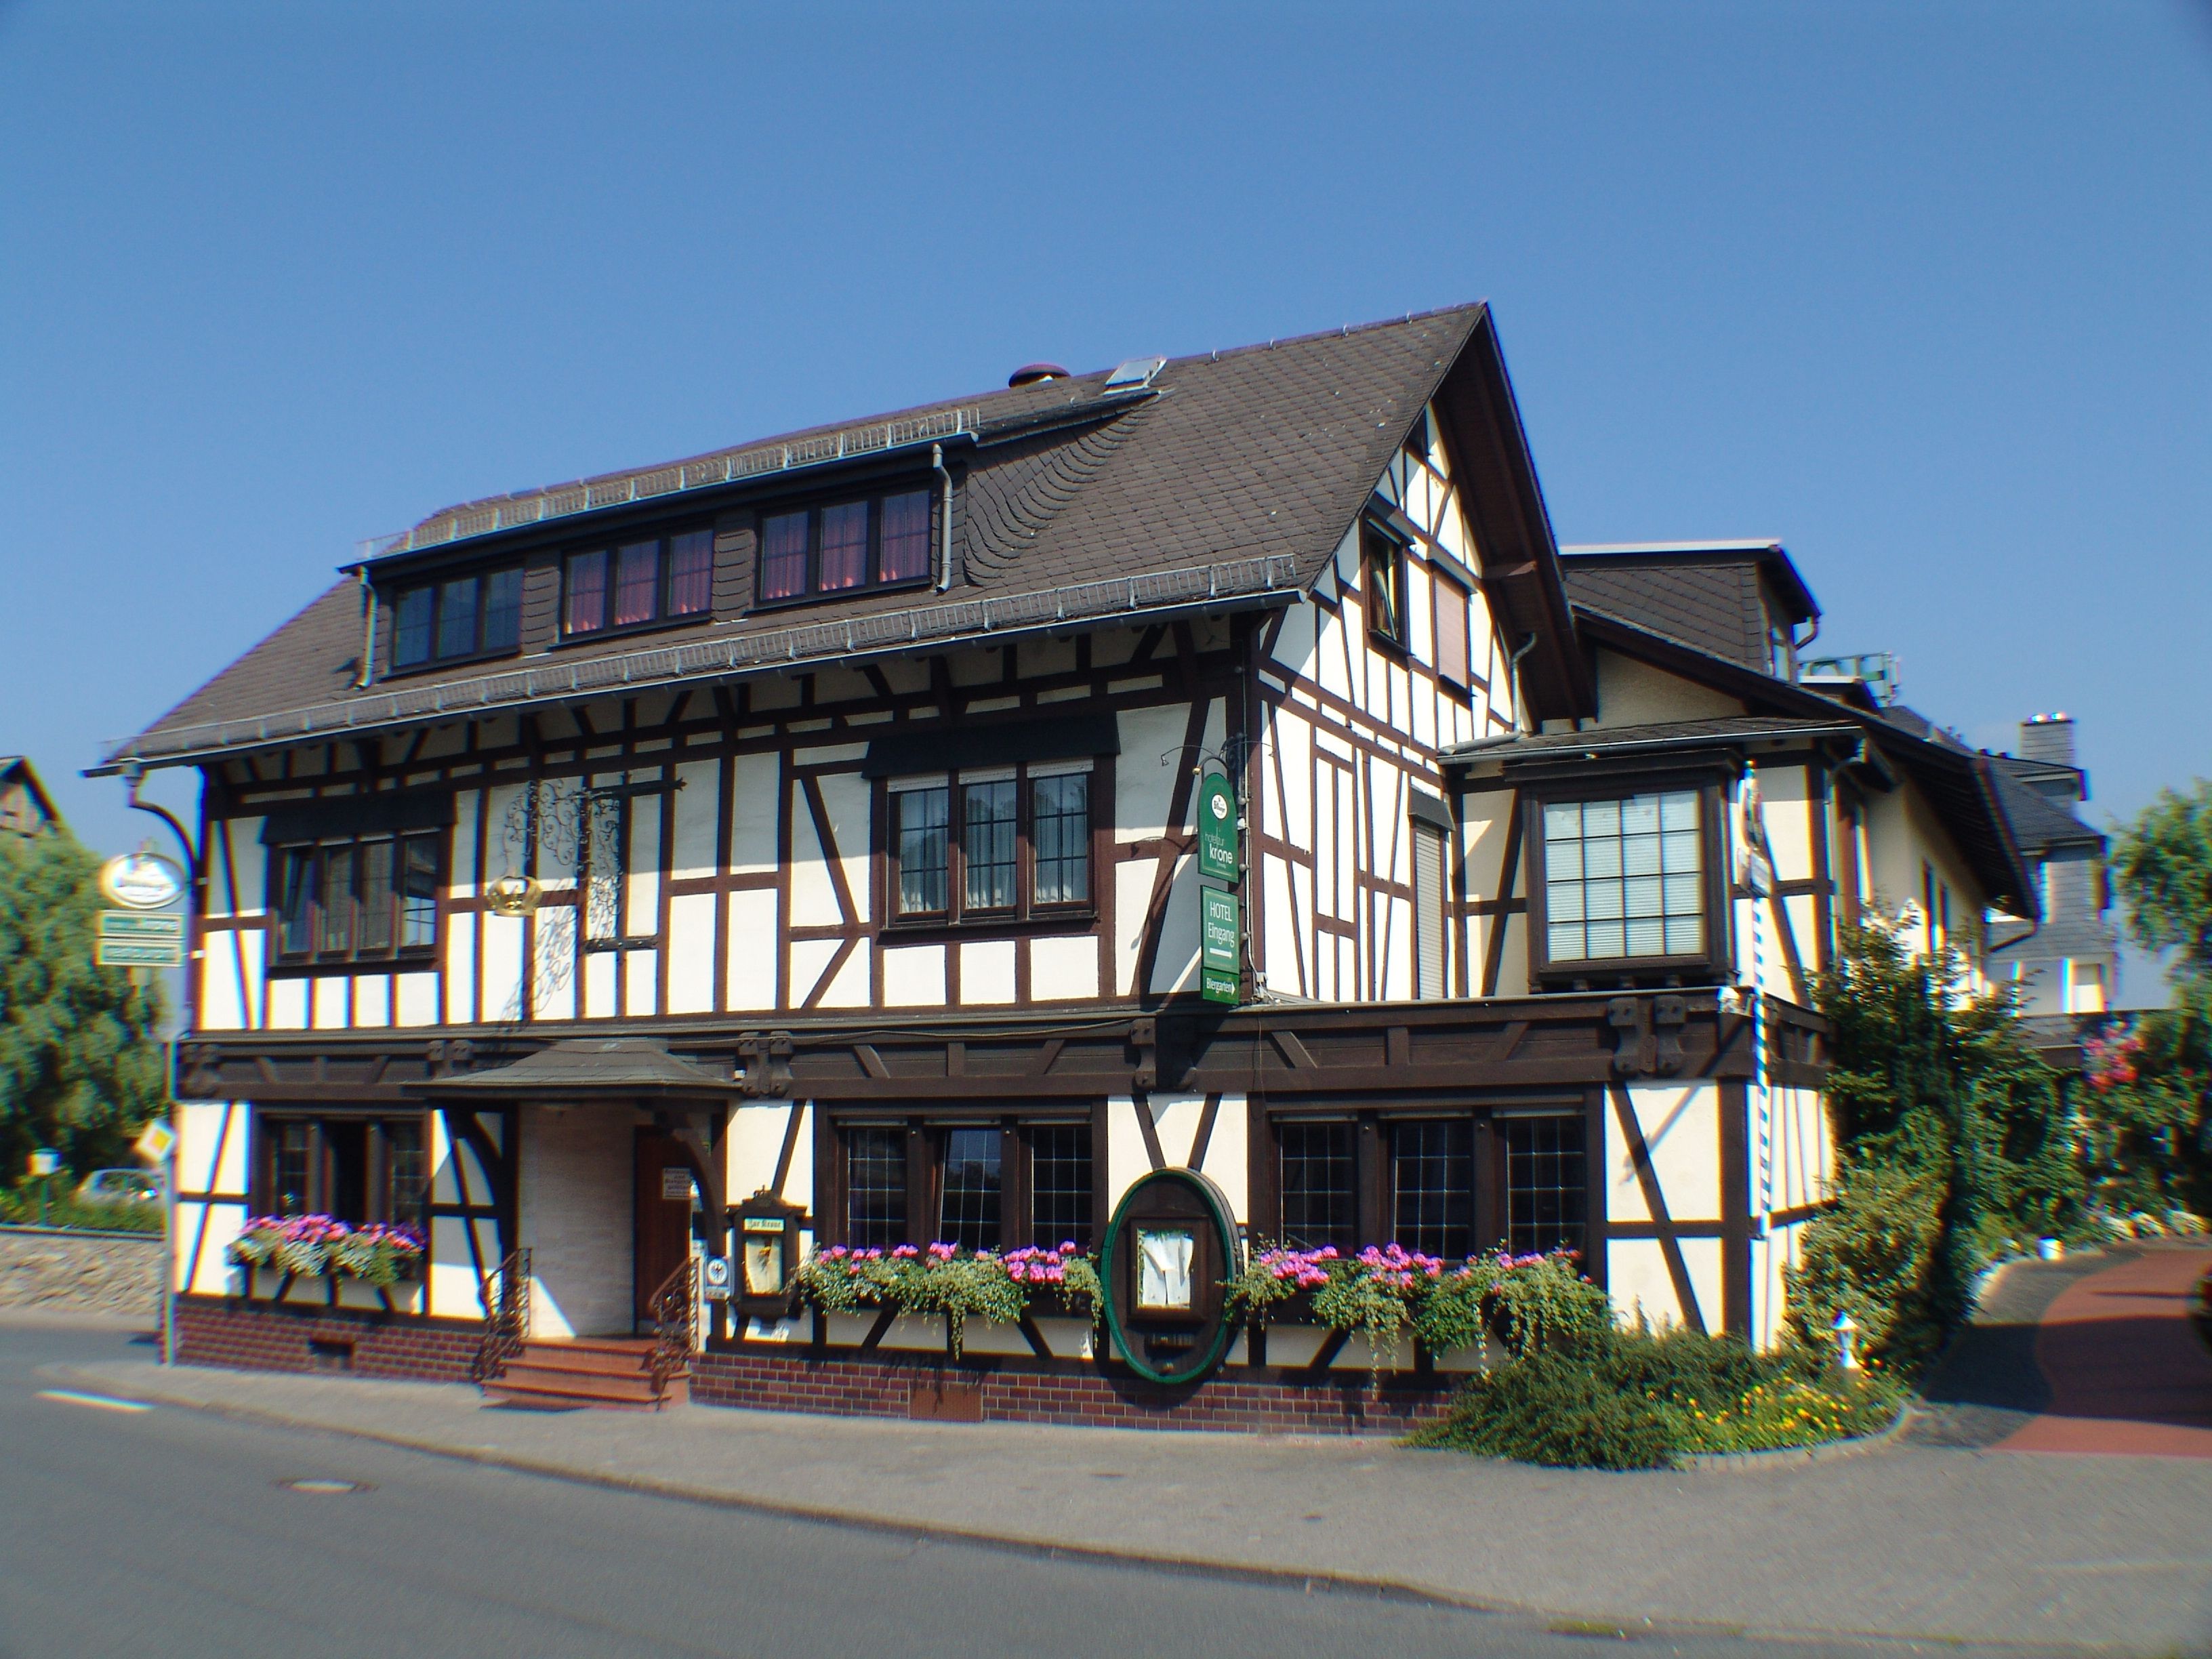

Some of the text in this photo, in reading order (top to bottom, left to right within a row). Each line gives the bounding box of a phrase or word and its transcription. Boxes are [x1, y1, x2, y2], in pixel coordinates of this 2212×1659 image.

[1210, 843, 1233, 864] krone
[1210, 901, 1232, 921] HOTEL
[1208, 922, 1235, 948] Eingang
[1206, 977, 1232, 994] Biergarten
